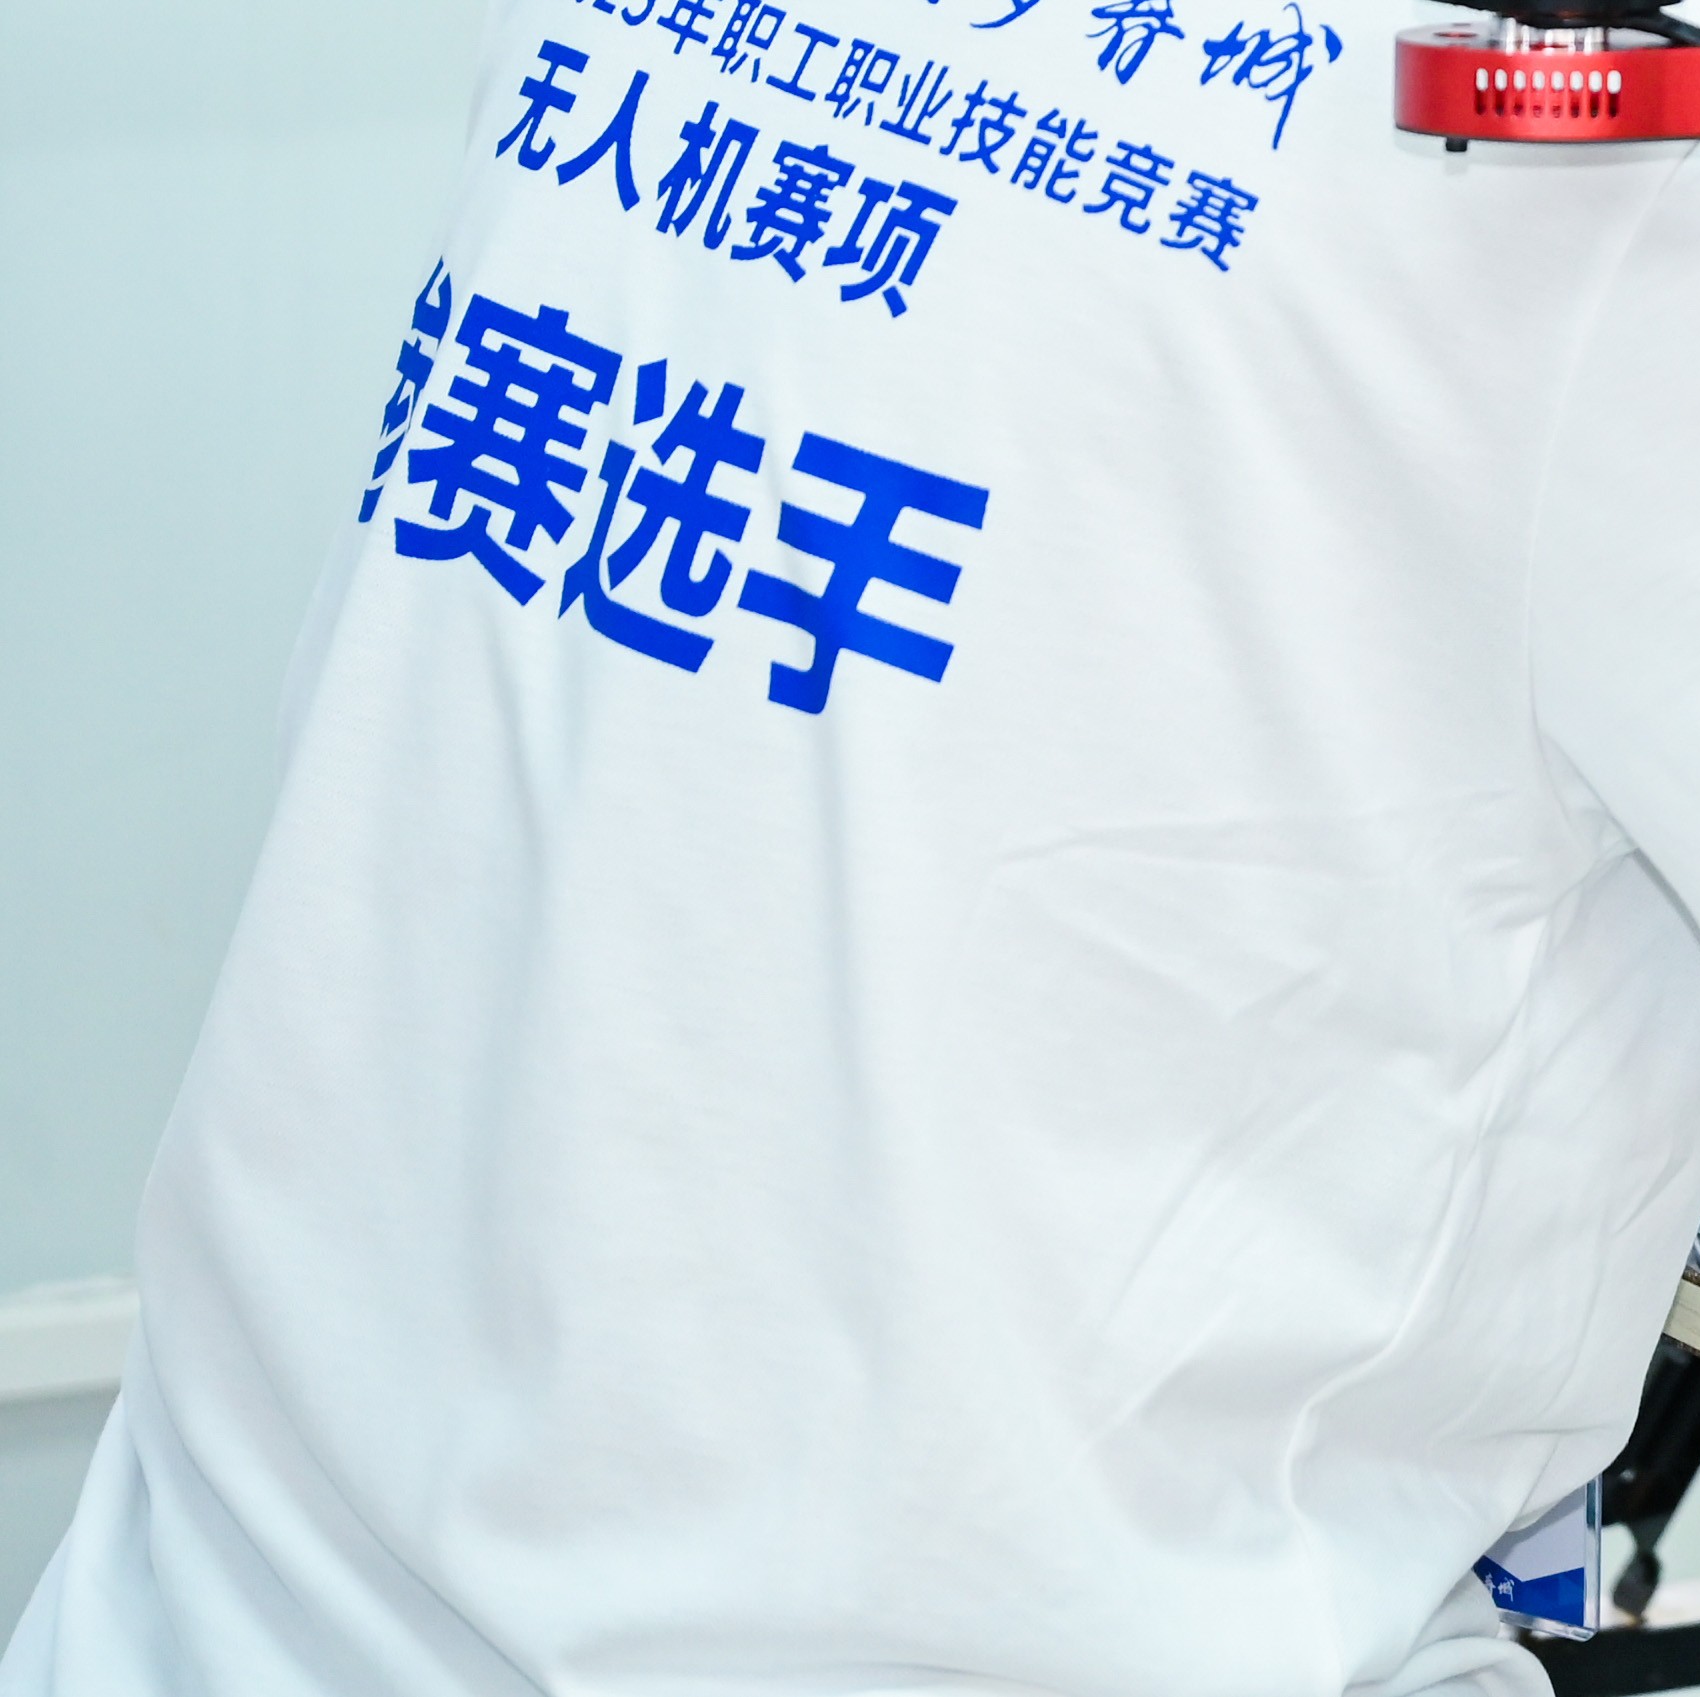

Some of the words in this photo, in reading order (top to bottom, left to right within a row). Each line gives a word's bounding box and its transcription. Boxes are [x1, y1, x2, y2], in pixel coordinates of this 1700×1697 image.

[496, 40, 957, 318] 无人机赛项
